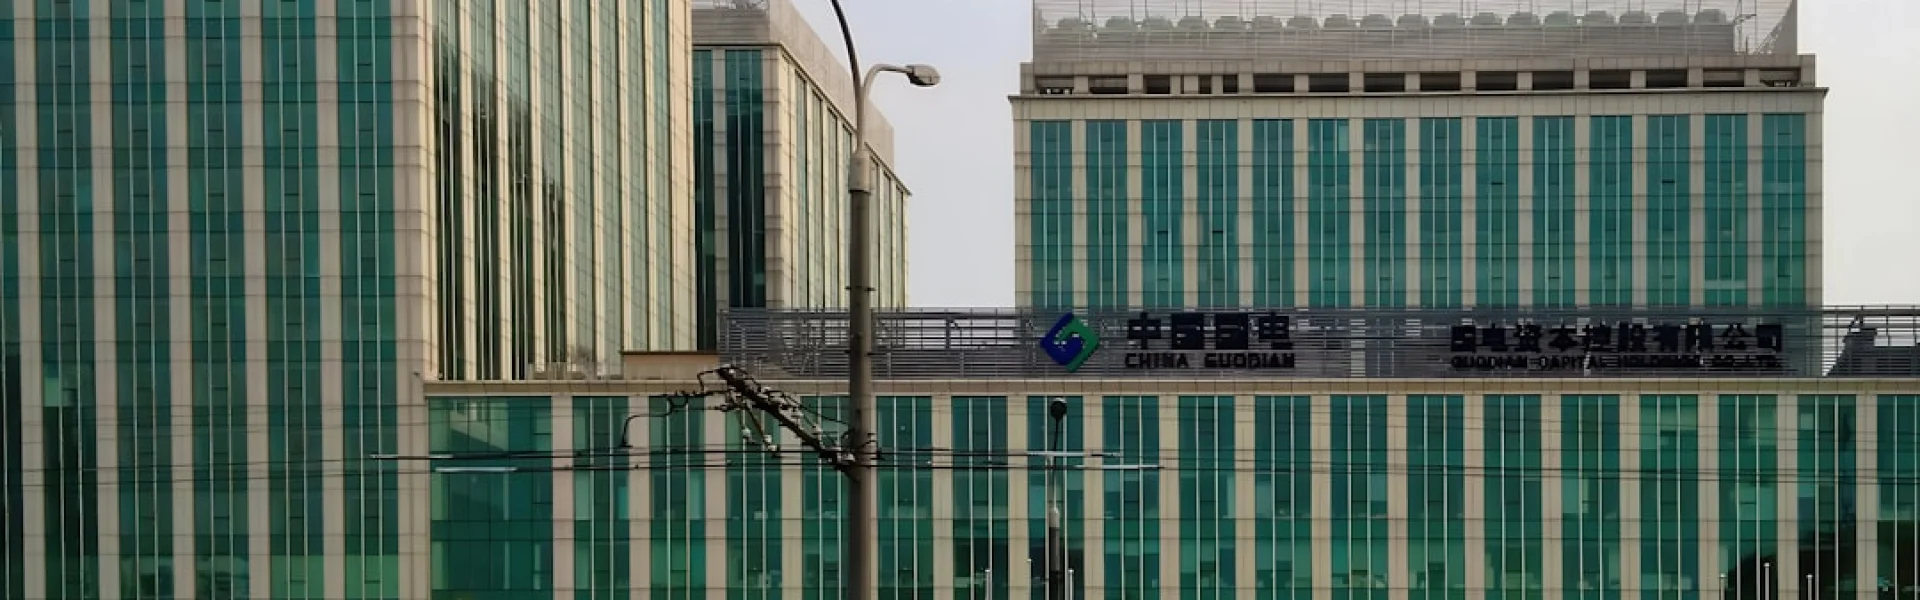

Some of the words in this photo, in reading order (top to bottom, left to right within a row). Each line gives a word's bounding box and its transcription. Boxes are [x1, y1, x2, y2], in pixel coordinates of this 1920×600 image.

[1127, 312, 1293, 350] 中国国电
[1125, 352, 1189, 368] CHINA
[1204, 352, 1294, 368] GUODIAN
